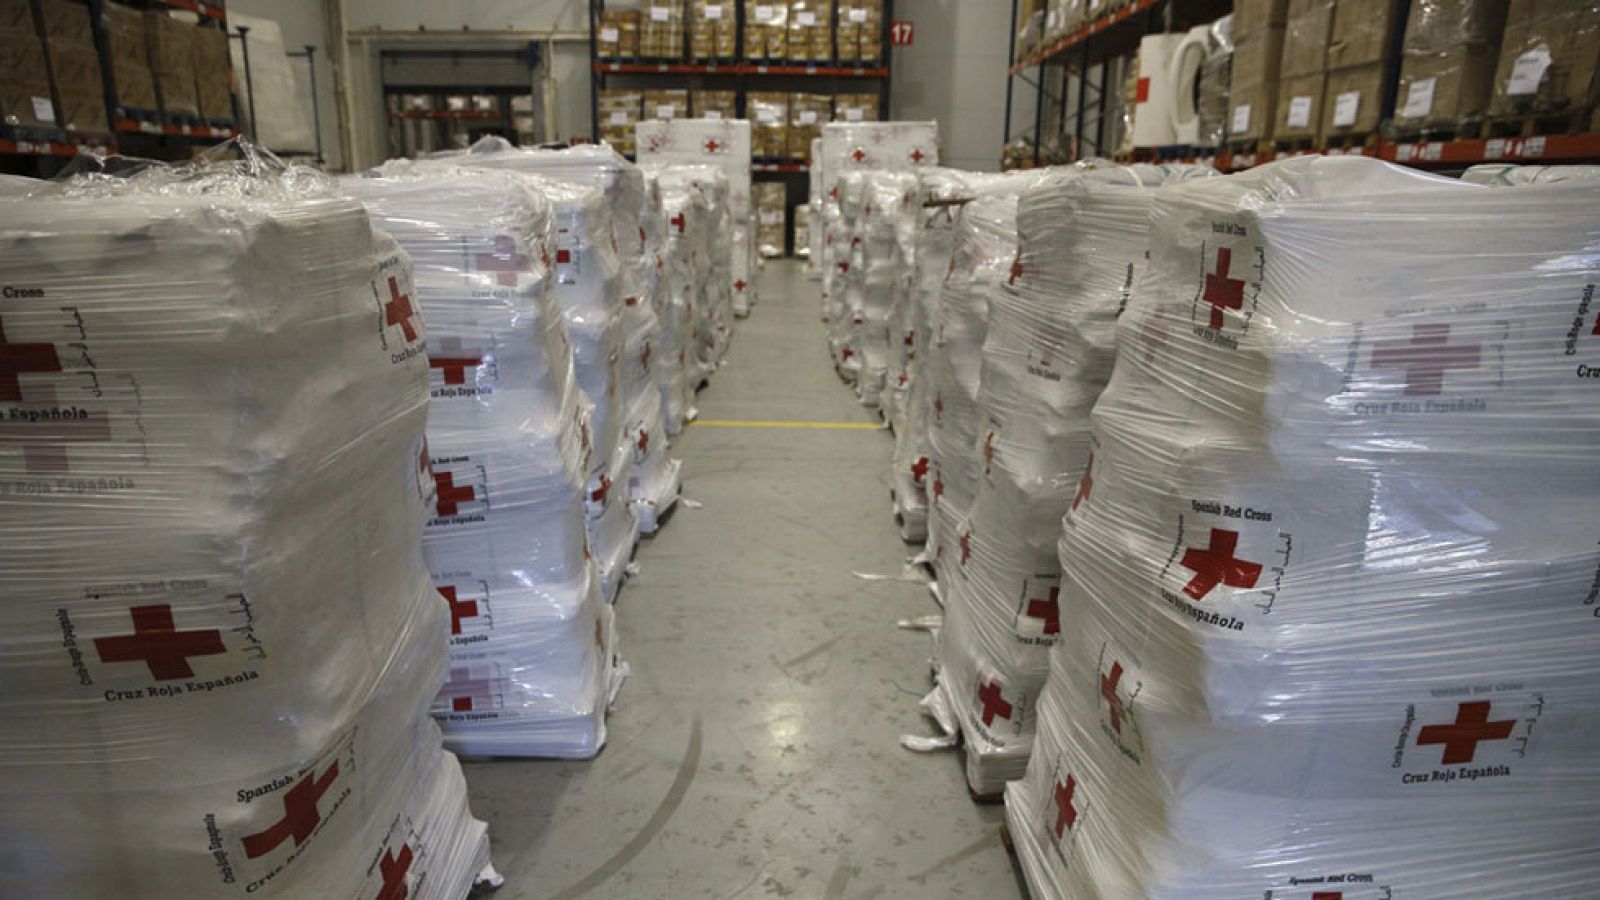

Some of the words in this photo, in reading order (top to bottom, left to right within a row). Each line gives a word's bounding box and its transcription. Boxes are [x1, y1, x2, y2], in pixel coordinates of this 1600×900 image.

[893, 22, 912, 44] 17
[2, 286, 45, 298] Cross
[1577, 364, 1600, 377] Cru
[458, 386, 492, 398] Espaola
[9, 406, 89, 424] Española
[1191, 500, 1221, 515] Spanish
[1223, 505, 1242, 518] Red
[1243, 508, 1273, 521] Cross
[103, 688, 144, 703] Cruz
[146, 684, 182, 698] Roja
[185, 670, 259, 693] Española
[1402, 772, 1429, 784] Cruz
[1431, 769, 1456, 783] Roja
[1459, 763, 1511, 781] Española
